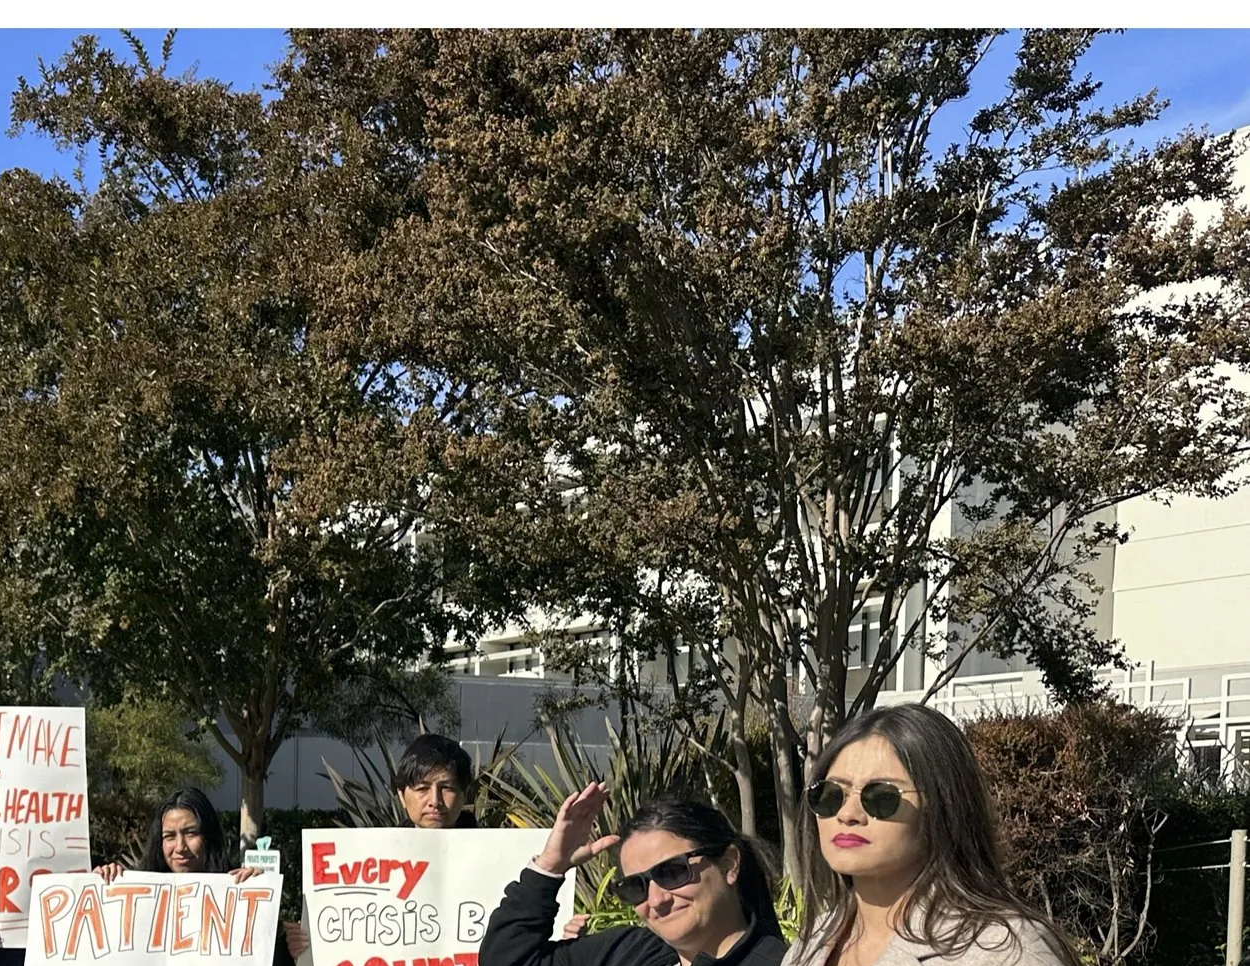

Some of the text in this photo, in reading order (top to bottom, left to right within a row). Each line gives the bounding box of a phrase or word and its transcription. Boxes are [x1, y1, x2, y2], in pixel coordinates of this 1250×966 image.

[7, 714, 80, 767] MAKE
[4, 788, 84, 824] HEALTH
[311, 842, 429, 900] Every
[39, 882, 274, 960] PATIENT
